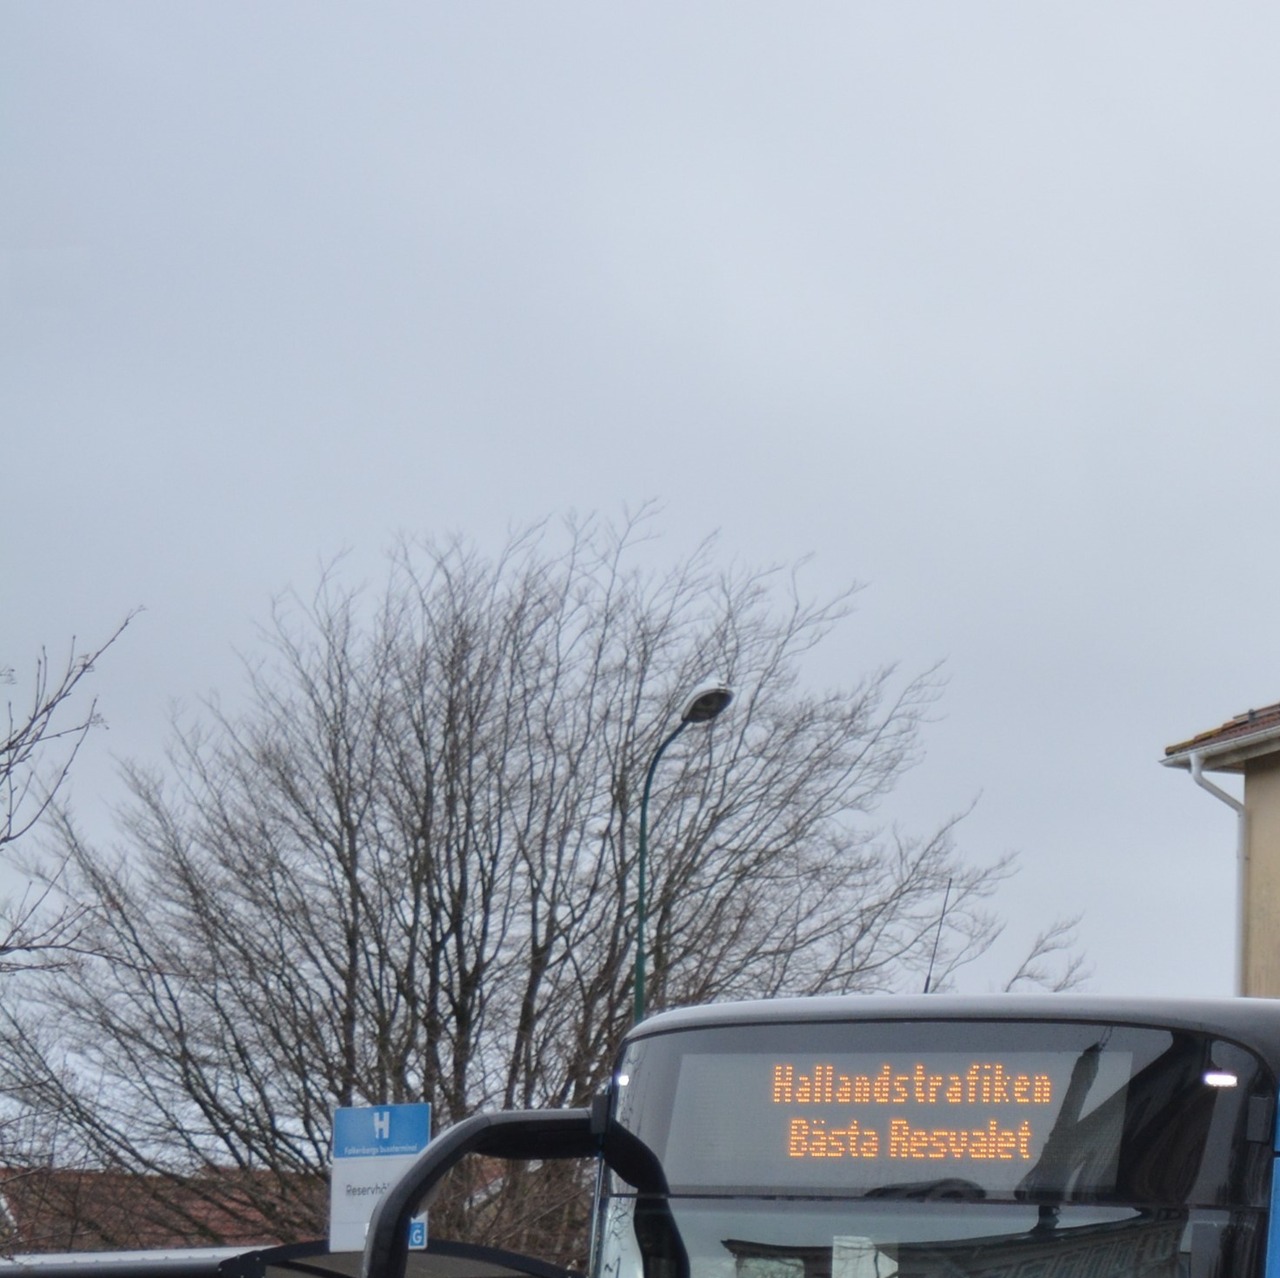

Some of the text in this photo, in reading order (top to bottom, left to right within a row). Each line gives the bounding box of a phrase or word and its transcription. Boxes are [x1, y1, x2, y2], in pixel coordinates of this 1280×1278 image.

[772, 1063, 1052, 1103] Hallandstrafiken
[789, 1118, 1032, 1160] Bästa Resvalet
[412, 1229, 422, 1244] G
